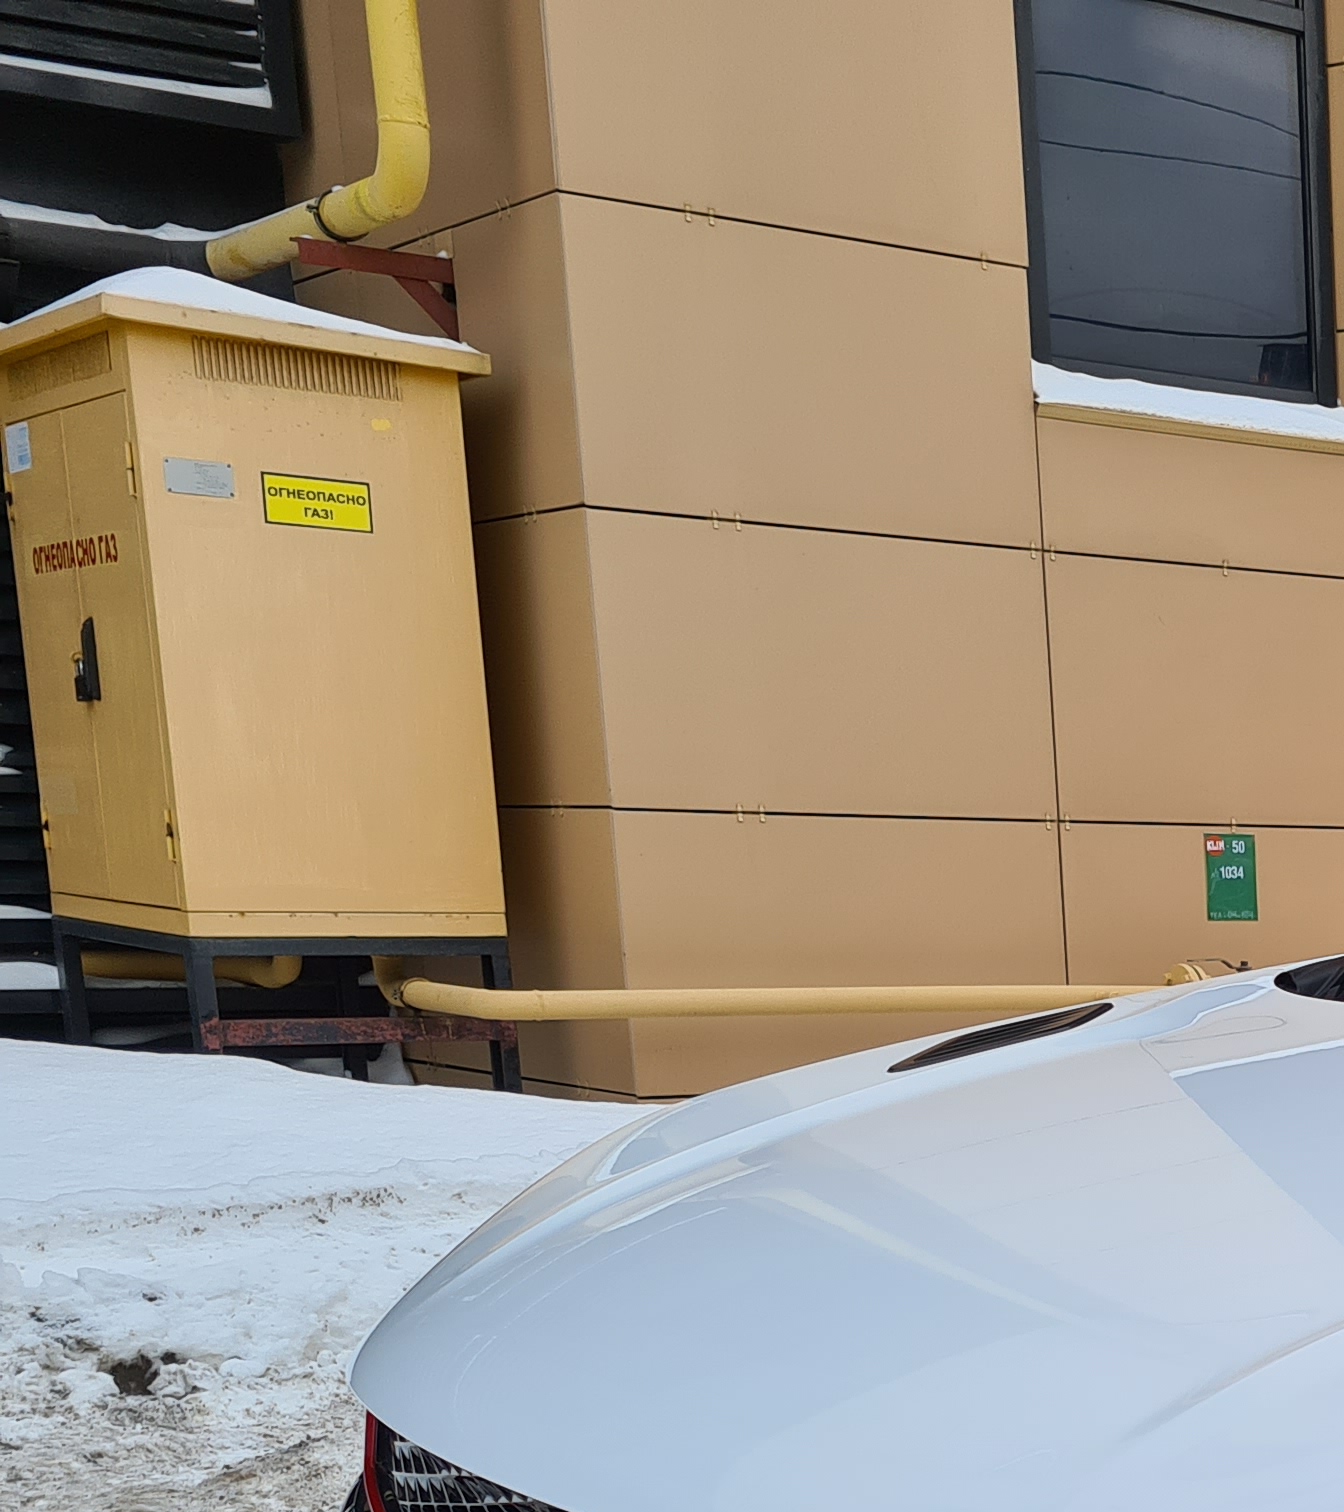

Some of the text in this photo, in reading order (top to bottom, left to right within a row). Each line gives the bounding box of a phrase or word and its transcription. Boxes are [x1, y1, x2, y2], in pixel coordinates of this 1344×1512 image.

[267, 486, 367, 506] ОГНЕОПАСНО
[303, 507, 334, 520] ГАЗ!
[32, 533, 119, 575] ОГНЕОПАСНО ГАЗ
[1232, 840, 1246, 854] 50
[1219, 865, 1244, 879] 1034
